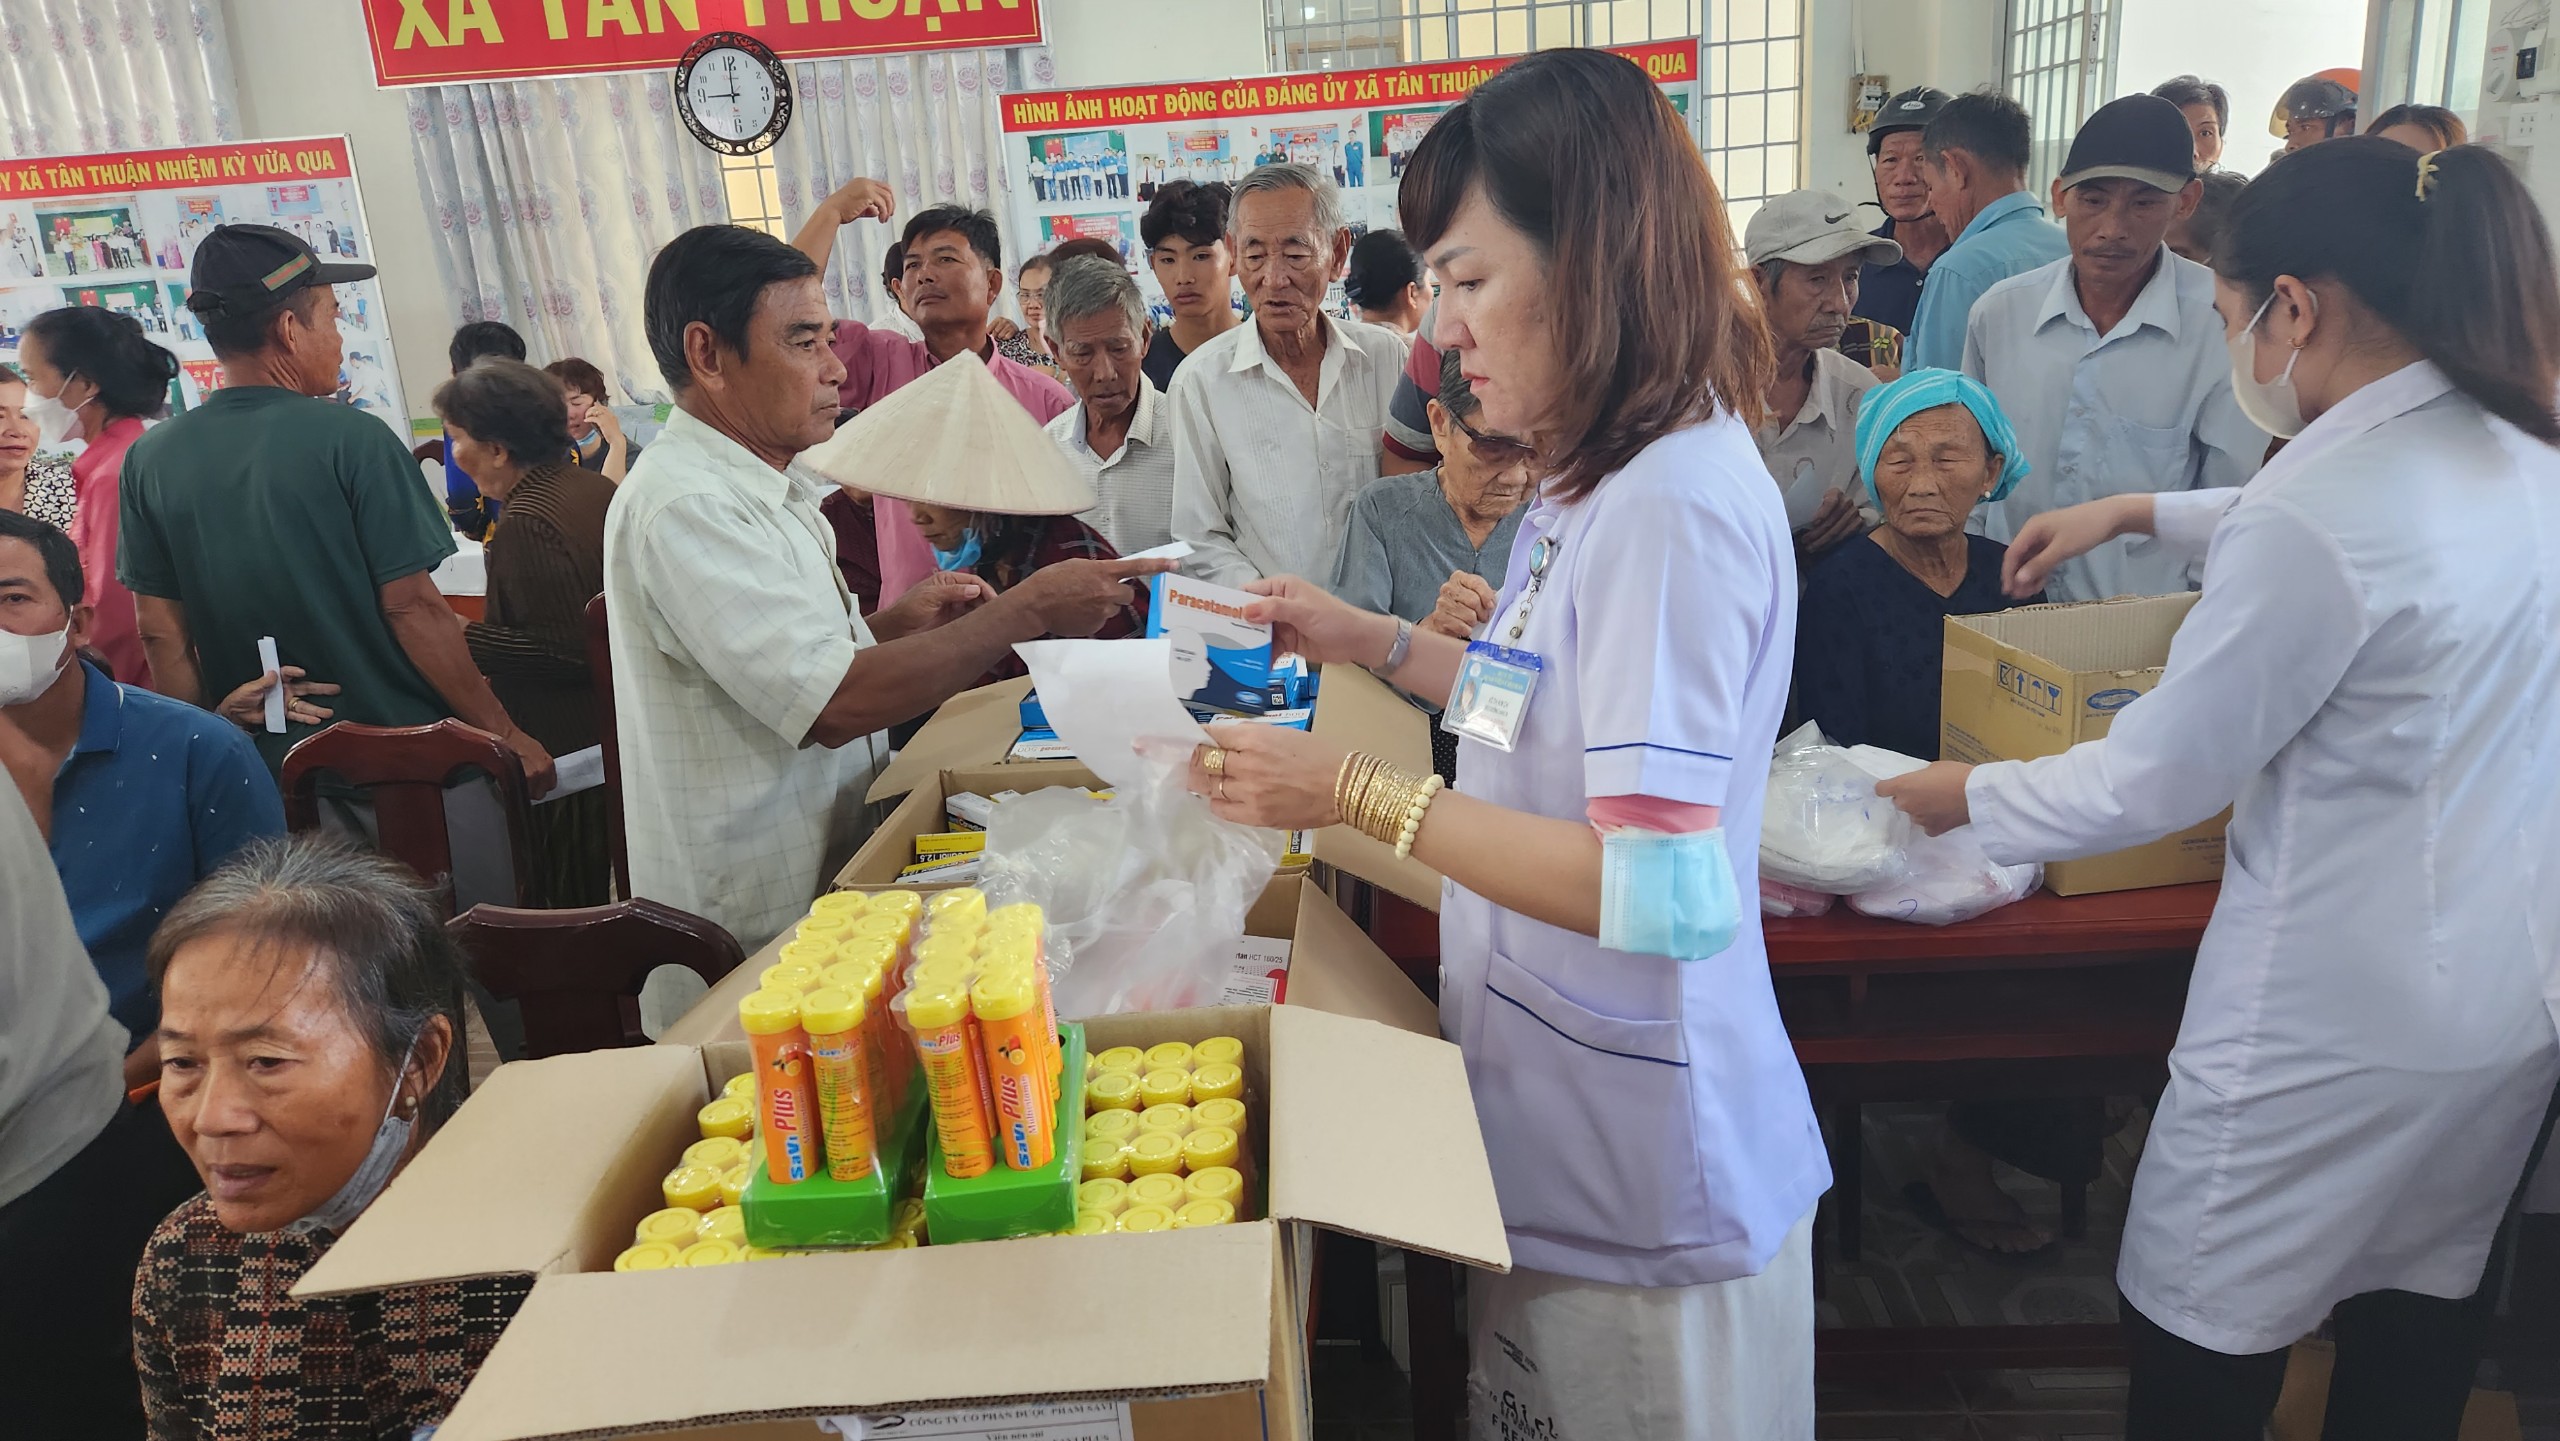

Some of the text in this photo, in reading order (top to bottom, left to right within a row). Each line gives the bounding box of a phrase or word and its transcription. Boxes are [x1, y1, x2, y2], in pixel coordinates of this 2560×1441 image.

[723, 56, 736, 71] 12
[700, 75, 707, 84] 10
[697, 88, 706, 103] 9
[761, 86, 770, 101] 3
[1013, 98, 1059, 124] HÌNH
[1065, 93, 1103, 121] ẢNH
[1109, 94, 1158, 120] HOẠT
[1164, 87, 1217, 117] ĐỘNG
[1222, 81, 1260, 109] CỦA
[1265, 78, 1317, 105] ĐẢNG
[1323, 74, 1349, 102] ỦY
[1354, 73, 1380, 100] XÃ
[1385, 70, 1423, 97] TÂN
[1647, 53, 1687, 79] QUA
[734, 118, 743, 134] 6
[0, 148, 336, 192] Y XÃ TÂN THUẬN NHIỆM KỲ VỪA QUA
[919, 853, 936, 863] 12.5
[1000, 1074, 1021, 1119] Plus
[773, 1088, 797, 1131] Plus
